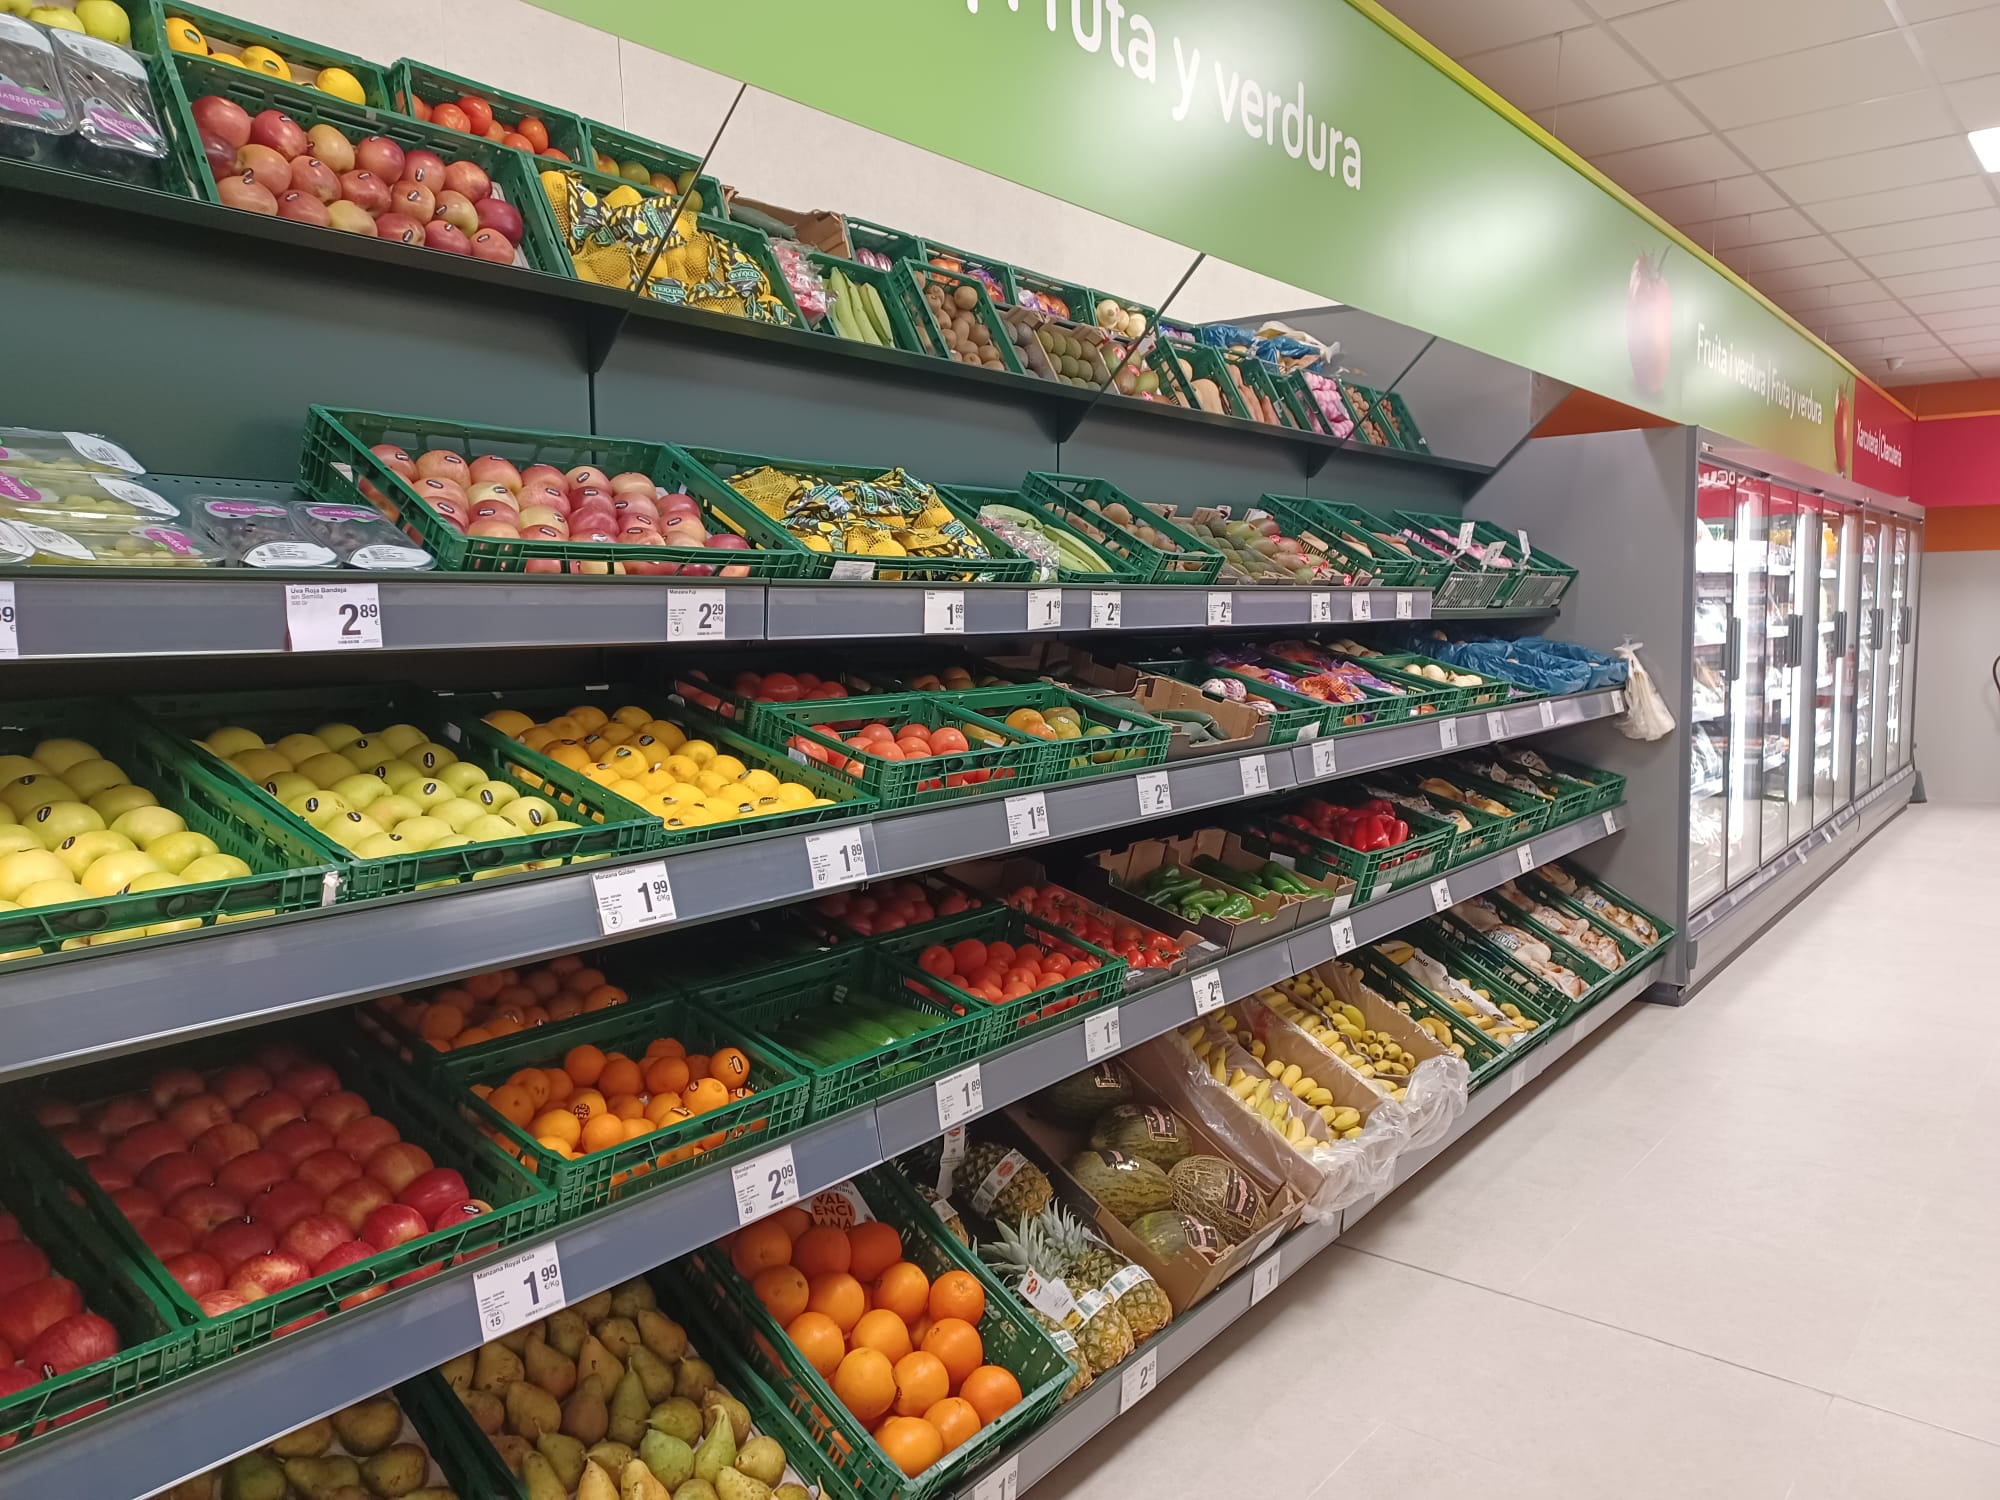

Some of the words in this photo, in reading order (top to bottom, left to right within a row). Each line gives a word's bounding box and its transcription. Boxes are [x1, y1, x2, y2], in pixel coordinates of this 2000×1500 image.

[1172, 36, 1200, 122] y
[1214, 60, 1361, 190] verdura
[1697, 322, 1727, 376] Fruita
[1735, 353, 1766, 397] verdura
[1772, 367, 1790, 409] Fruta
[1790, 390, 1797, 420] y
[1797, 388, 1822, 424] verdura
[476, 1265, 504, 1281] Manzana
[504, 1257, 521, 1270] Royal
[521, 1253, 535, 1263] Gala
[490, 1315, 501, 1327] 15
